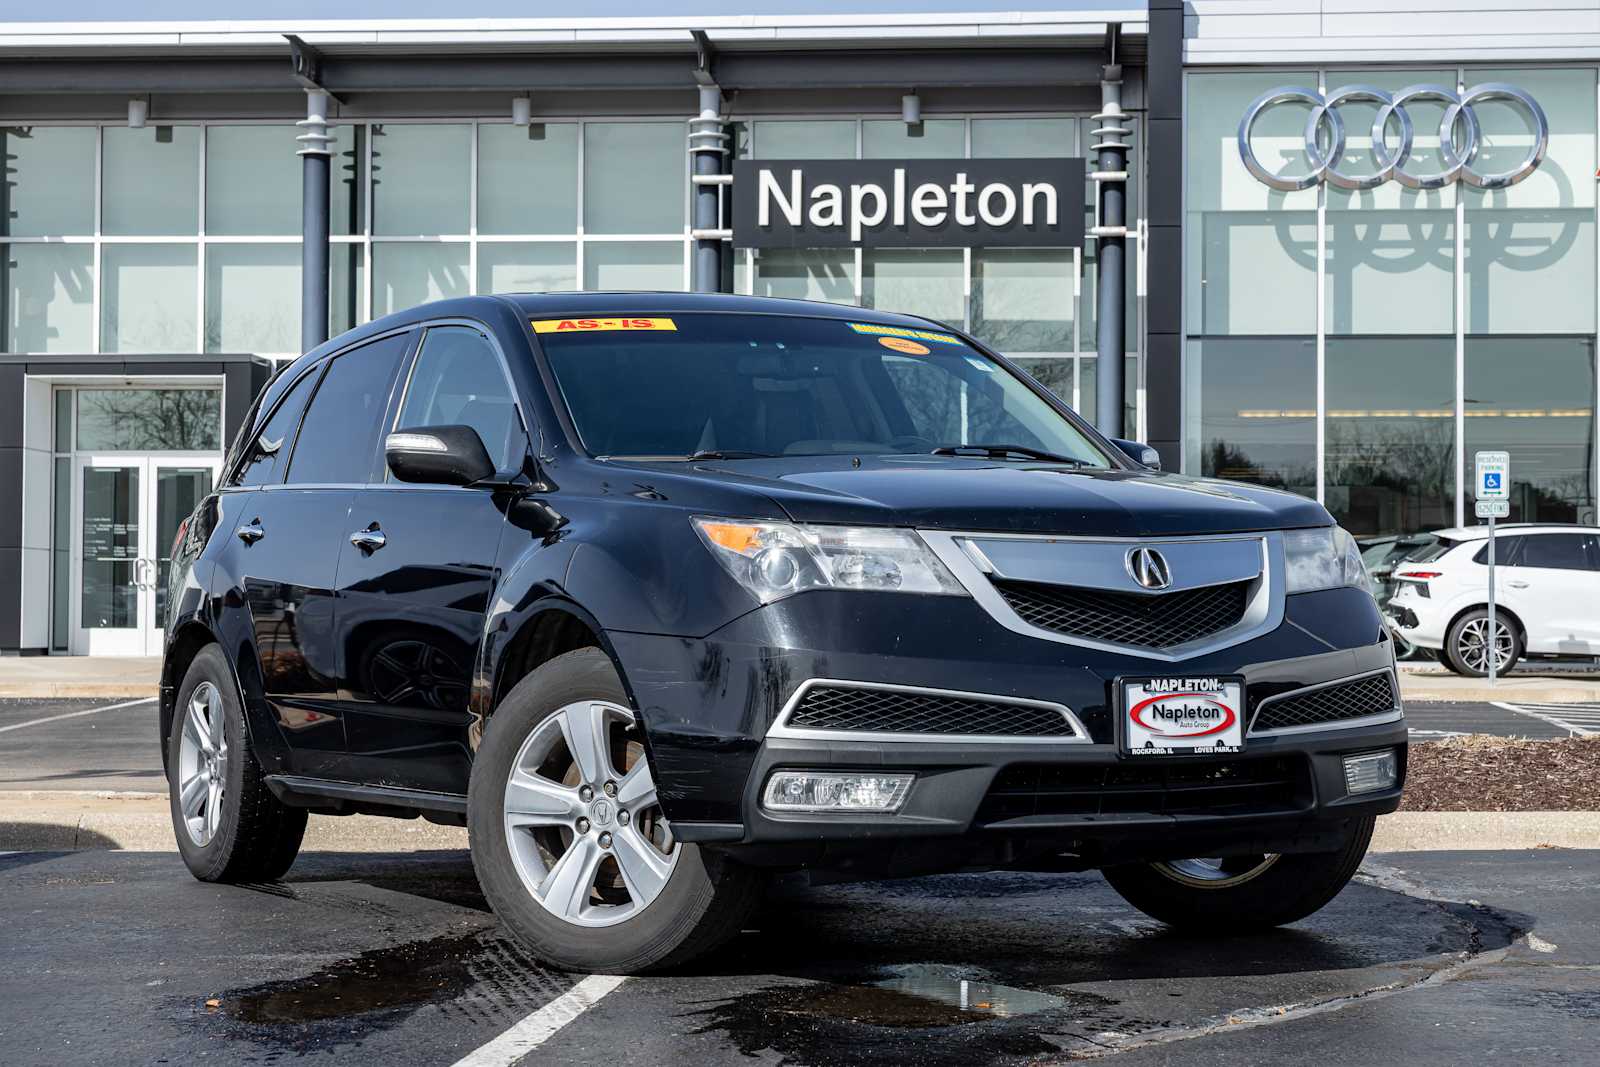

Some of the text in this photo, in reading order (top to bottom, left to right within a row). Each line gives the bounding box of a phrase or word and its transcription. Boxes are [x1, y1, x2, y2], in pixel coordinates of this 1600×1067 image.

[758, 168, 1058, 242] Napleton
[1151, 679, 1218, 691] NAPLETON
[1152, 704, 1220, 723] Napleton
[1194, 721, 1210, 729] Group
[1194, 746, 1213, 754] LOVES
